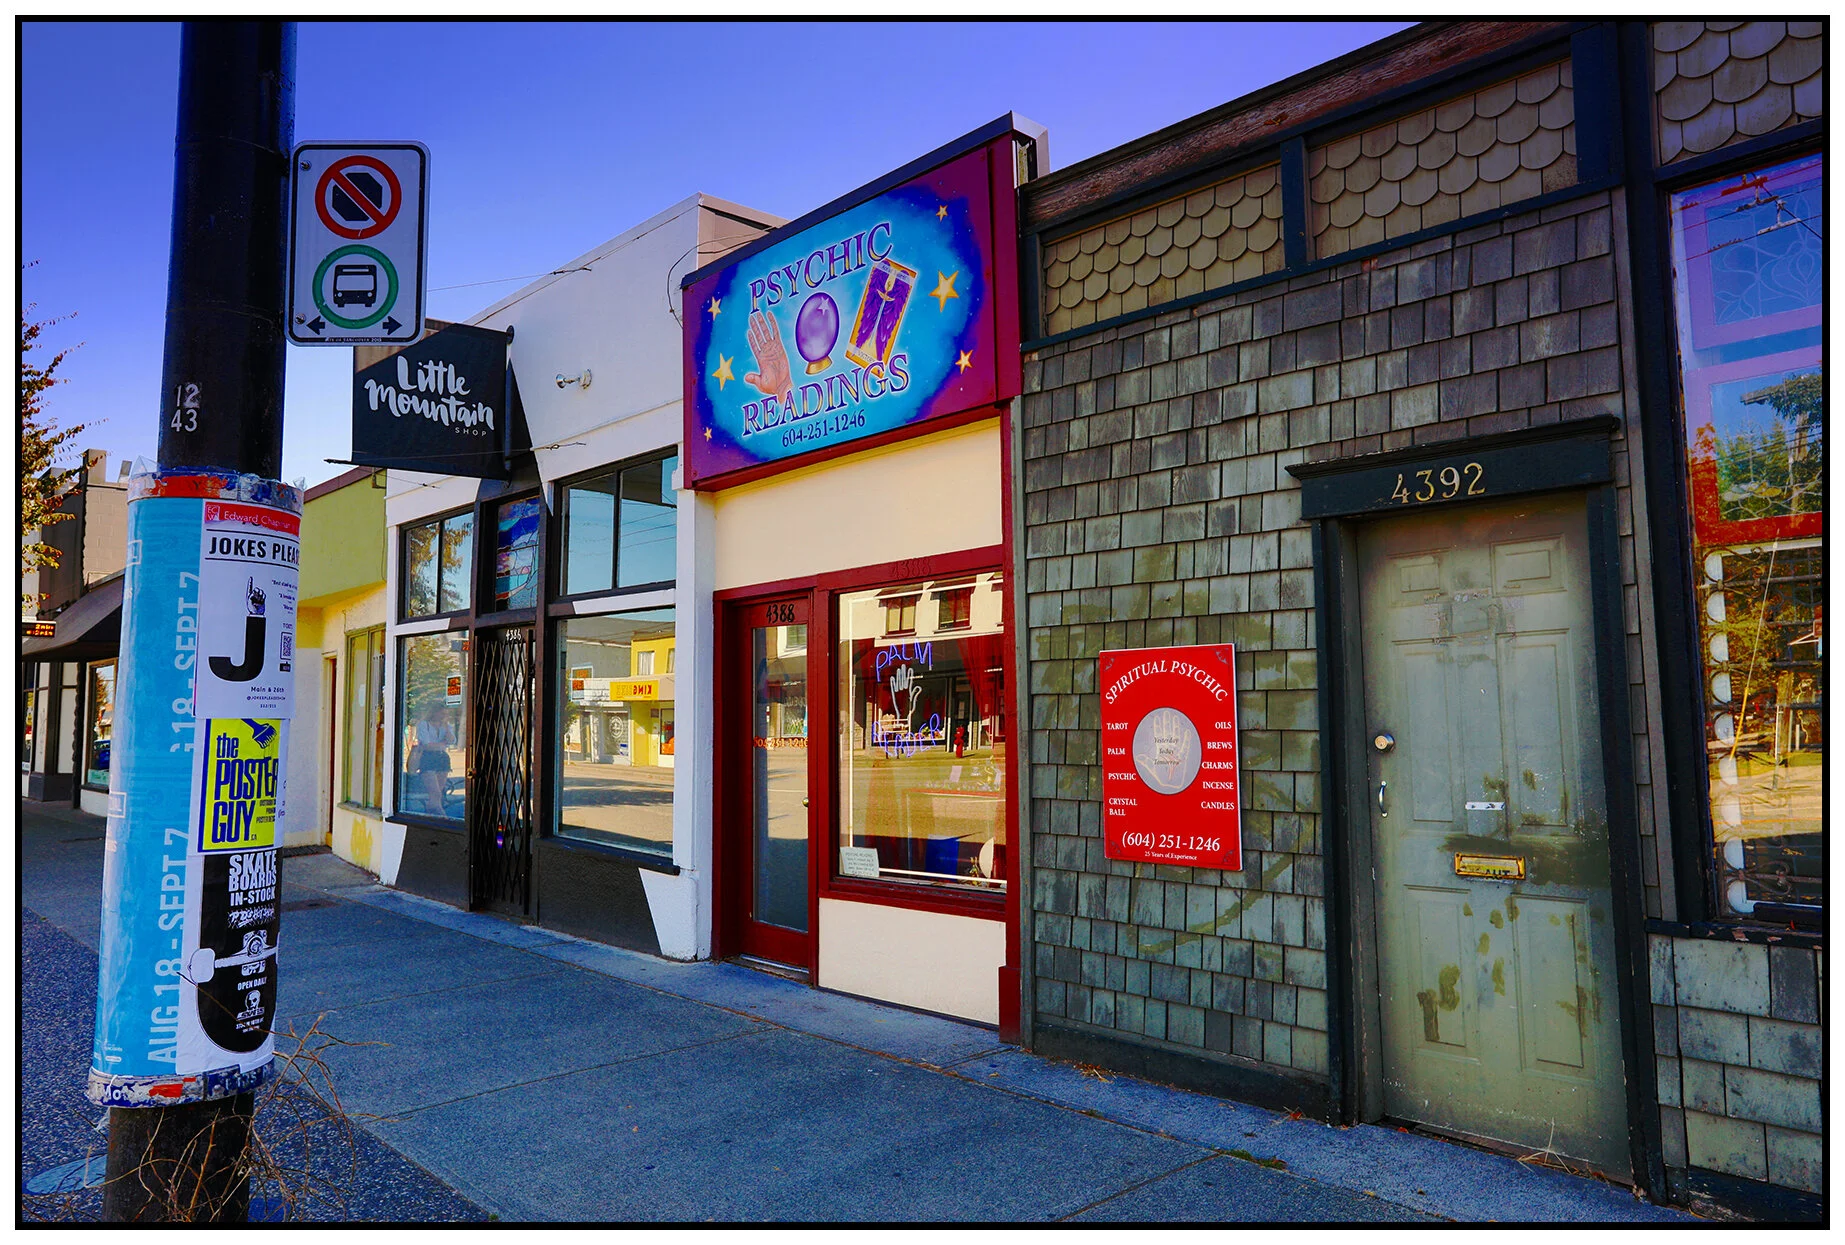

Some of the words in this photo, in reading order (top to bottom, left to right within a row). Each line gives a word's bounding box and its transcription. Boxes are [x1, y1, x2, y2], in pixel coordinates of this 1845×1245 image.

[750, 222, 893, 314] PSYCHIC
[397, 355, 471, 396] Little
[177, 383, 200, 409] 12
[364, 378, 495, 431] Mountain
[742, 354, 909, 436] READINGS
[171, 409, 198, 432] 43
[782, 408, 866, 448] 604-251-1246
[454, 427, 487, 437] SHOP
[1391, 462, 1486, 504] 4392
[224, 510, 260, 524] Edward
[209, 537, 267, 559] JOKES
[765, 603, 796, 624] 4388
[875, 638, 933, 683] PALM
[1105, 660, 1168, 705] SPIRITUAL
[1170, 660, 1229, 702] PSYCHIC
[871, 712, 942, 758] READER
[1106, 722, 1129, 731] TAROT
[1214, 721, 1232, 730] OILS
[216, 732, 240, 759] the
[1107, 747, 1126, 756] PALM
[1206, 741, 1233, 750] BREWS
[1108, 772, 1137, 781] PSYCHIC
[1201, 761, 1234, 770] CHARMS
[214, 757, 279, 801] POSTER
[1202, 781, 1235, 790] INCENSE
[1108, 797, 1138, 807] CRYSTAL
[1108, 808, 1127, 816] BALL
[1200, 801, 1235, 811] CANDLES
[211, 800, 256, 843] GUY
[1122, 831, 1156, 850] (604)
[1159, 834, 1221, 852] 251-1246
[229, 850, 277, 875] SKATE
[1170, 852, 1198, 861] Experience
[228, 866, 277, 892] BOARDS
[230, 886, 276, 907] IN-STOCK
[154, 958, 183, 999] 18
[237, 980, 253, 991] OPEN
[253, 976, 267, 989] DAILY
[147, 1006, 180, 1064] AUG
